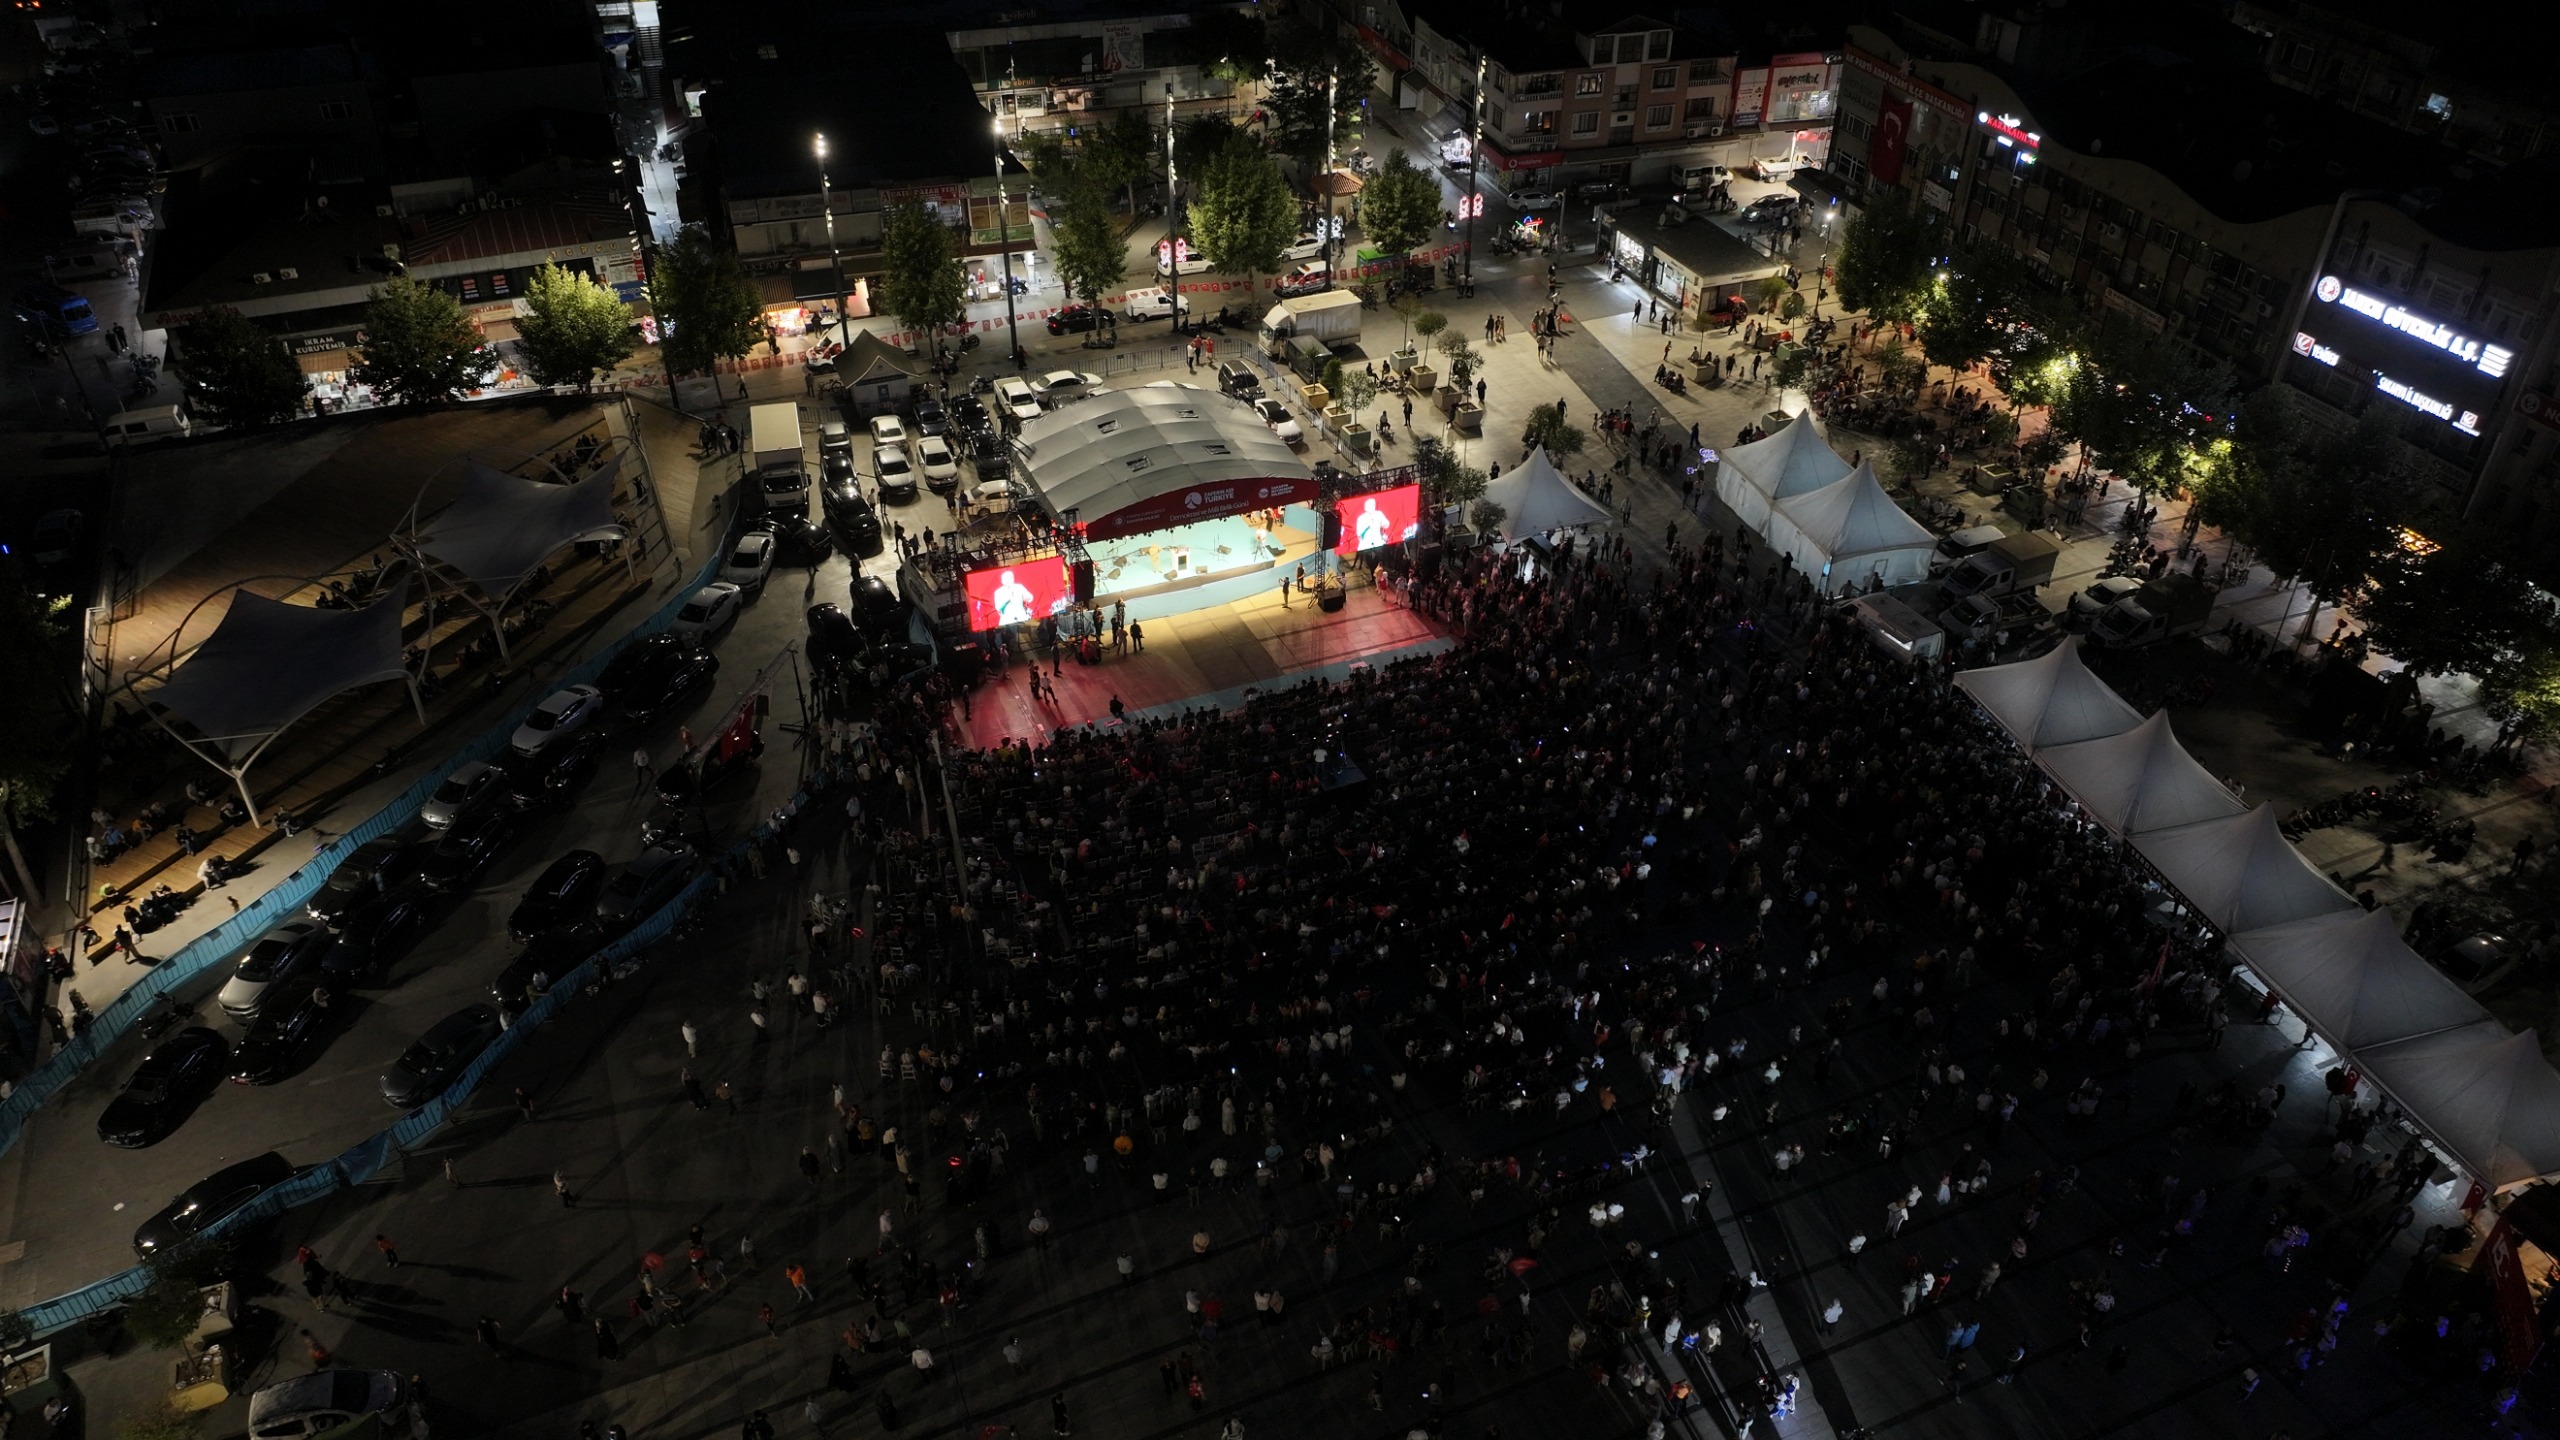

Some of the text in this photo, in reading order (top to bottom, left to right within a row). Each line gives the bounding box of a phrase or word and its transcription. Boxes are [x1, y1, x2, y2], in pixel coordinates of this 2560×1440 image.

[2383, 306, 2453, 350] GÜVENLİK
[1204, 493, 1234, 503] TÜRKİYE
[1170, 511, 1200, 521] Demokrasi
[1233, 500, 1249, 509] Günü
